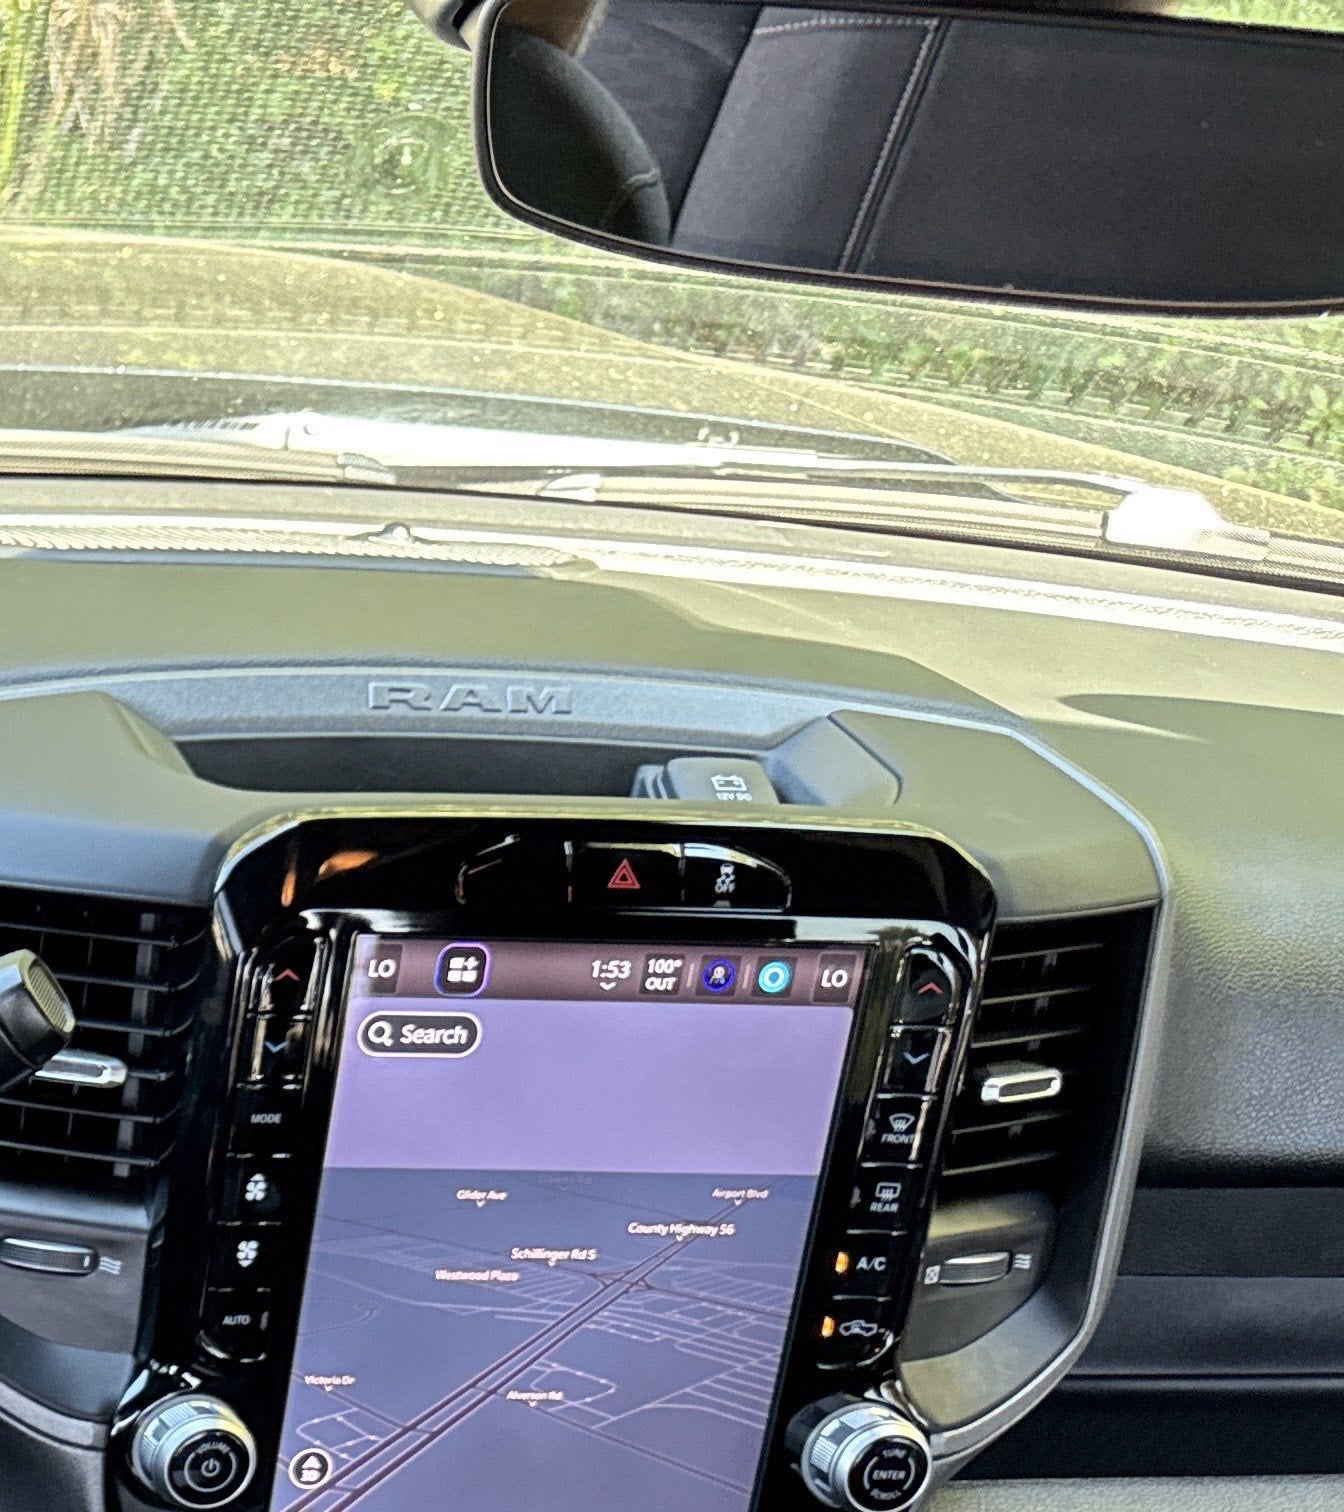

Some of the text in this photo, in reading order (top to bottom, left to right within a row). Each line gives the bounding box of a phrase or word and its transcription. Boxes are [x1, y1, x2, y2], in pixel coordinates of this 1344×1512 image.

[368, 681, 572, 715] RAM
[368, 959, 395, 978] LO
[591, 959, 632, 980] 1:53
[645, 975, 676, 992] OUT
[822, 970, 848, 988] LO
[400, 1025, 469, 1046] Search
[250, 1112, 282, 1124] MODE
[881, 1133, 916, 1144] FRONT
[712, 1188, 769, 1200] Airport Blvd
[870, 1202, 899, 1213] REAR
[628, 1223, 667, 1235] County
[670, 1224, 717, 1236] Highway
[511, 1248, 570, 1260] Schillinger
[572, 1249, 585, 1260] Rd
[856, 1257, 887, 1271] A/C
[436, 1270, 519, 1281] Westwood Plaza
[222, 1314, 251, 1326] AUTO
[305, 1375, 338, 1385] Victoria
[549, 1391, 564, 1400] Rd
[873, 1470, 906, 1480] ENTER
